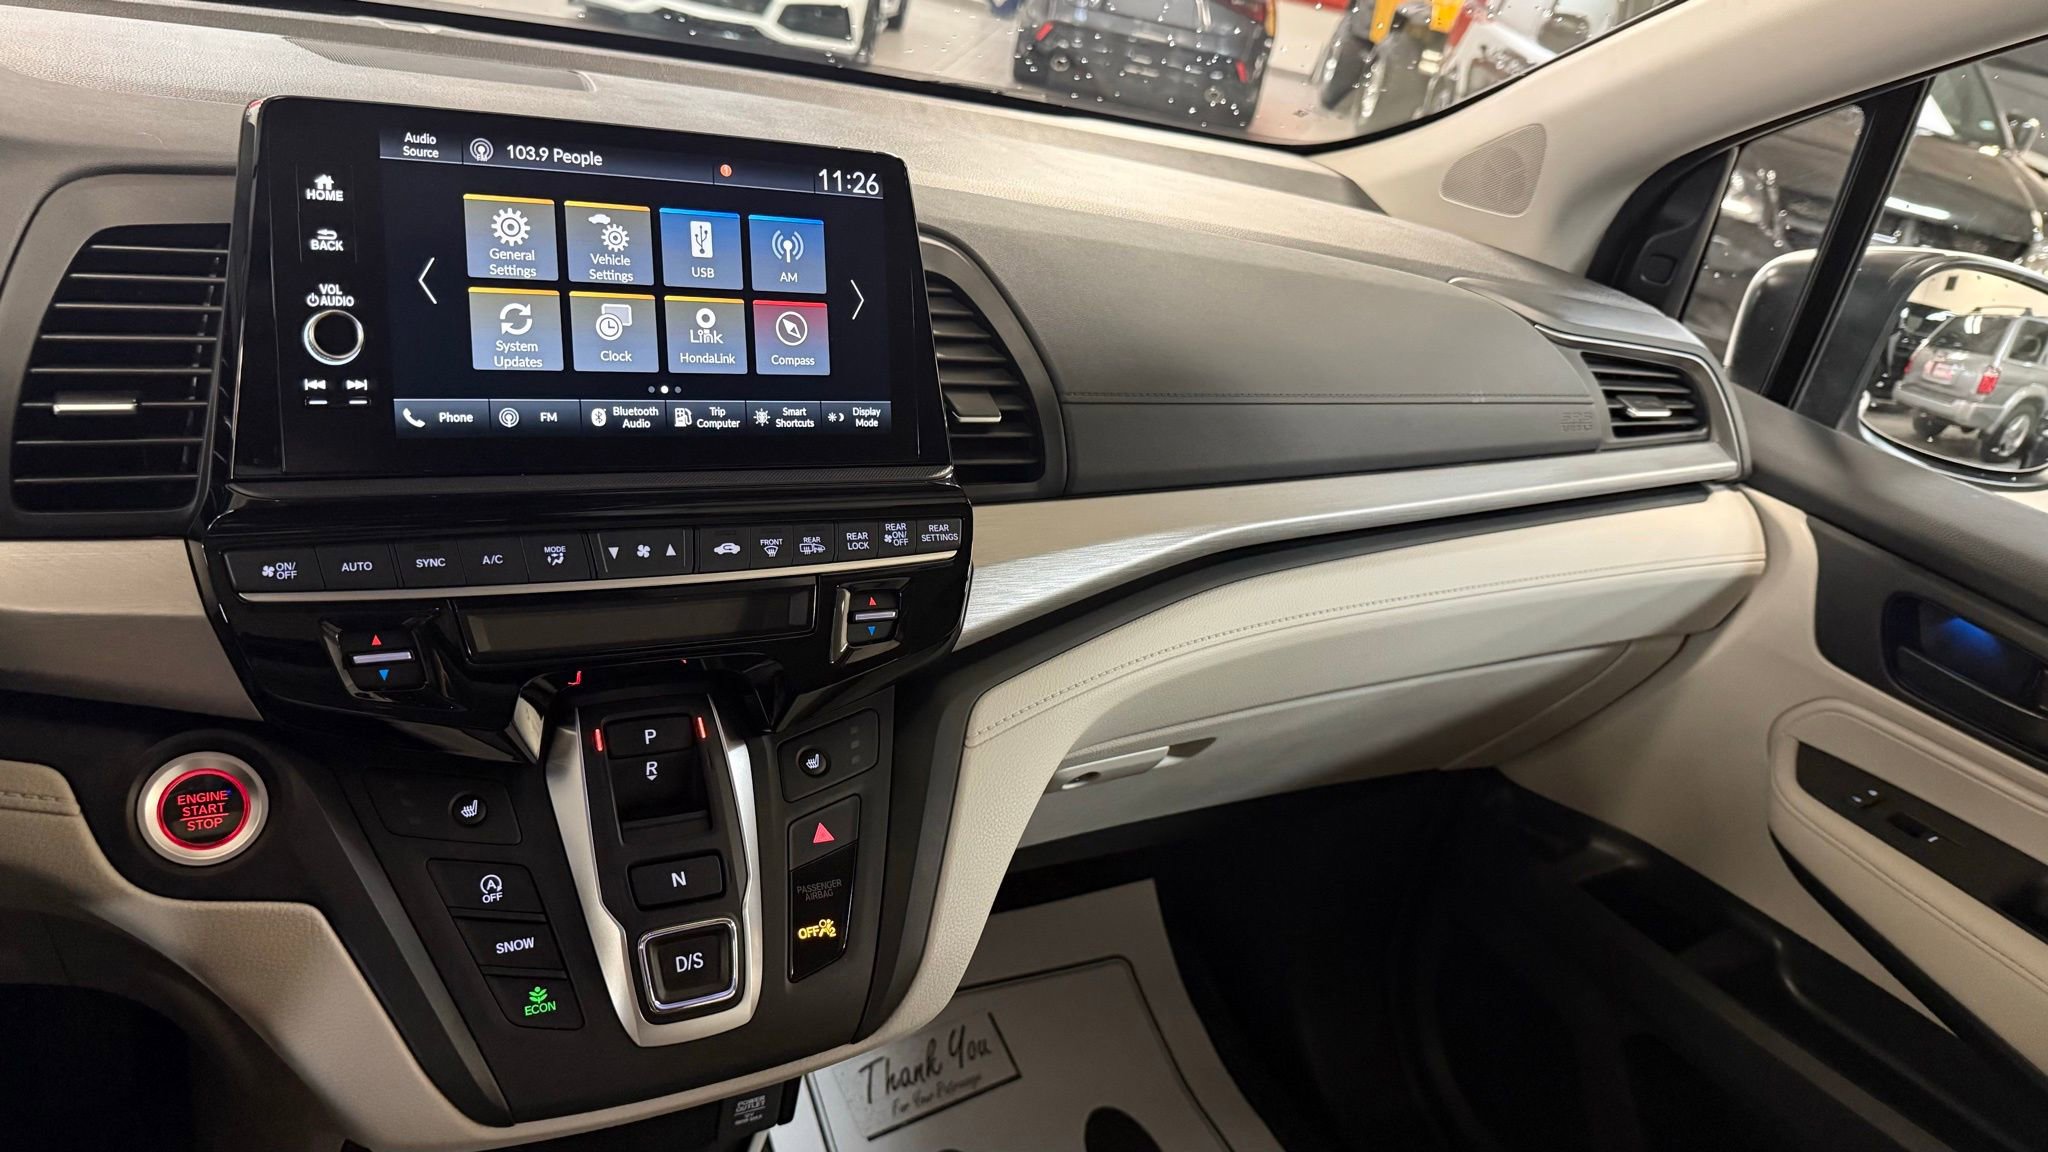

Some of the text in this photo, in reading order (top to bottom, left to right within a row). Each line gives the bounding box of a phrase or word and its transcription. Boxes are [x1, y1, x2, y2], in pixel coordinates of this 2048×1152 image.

[404, 132, 437, 145] Audio
[403, 146, 439, 158] Source
[506, 144, 603, 168] 103.9 People
[818, 168, 880, 195] 11:26
[305, 188, 344, 201] HOME
[310, 239, 344, 251] BACK
[489, 248, 536, 261] General
[590, 253, 631, 266] Vehicle
[489, 264, 537, 278] Settings
[589, 269, 634, 283] Settings
[691, 267, 715, 279] USB
[780, 272, 798, 283] AM
[319, 283, 343, 295] VOL
[320, 296, 355, 307] AUDIO
[496, 340, 538, 354] System
[600, 350, 632, 362] Clock
[680, 352, 736, 365] HondaLink
[771, 354, 815, 367] Compass
[494, 356, 543, 369] Updates
[439, 411, 473, 423] Phone
[540, 412, 558, 423] FM
[613, 406, 659, 417] Bluetooth
[709, 407, 726, 417] Trip
[782, 407, 806, 417] Smart
[852, 407, 881, 418] Display
[622, 418, 651, 429] Audio
[697, 419, 740, 430] Computer
[775, 418, 815, 428] Shortcuts
[855, 418, 878, 428] Mode
[885, 522, 907, 532] REAR
[928, 524, 950, 533] REAR
[803, 536, 821, 544] REAR
[846, 531, 869, 541] REAR
[892, 531, 907, 540] ON/
[921, 533, 959, 543] SETTINGS
[760, 538, 784, 547] FRONT
[847, 541, 870, 551] LOCK
[893, 537, 909, 547] OFF
[544, 545, 567, 554] MODE
[275, 561, 296, 572] ON/
[416, 557, 446, 569] SYNC
[482, 555, 504, 566] A/C
[341, 561, 373, 573] AUTO
[276, 569, 298, 580] OFF
[644, 728, 657, 745] P
[645, 761, 658, 776] R
[177, 790, 229, 806] ENGINE
[182, 802, 226, 817] START
[187, 817, 223, 831] STOP
[486, 879, 497, 891] A
[671, 871, 687, 887] N
[796, 878, 843, 895] PASSENGER
[482, 892, 503, 904] OFF
[805, 888, 834, 901] AIRBAG
[797, 925, 820, 940] OFF
[495, 936, 535, 954] SNOW
[675, 952, 704, 972] D/S
[524, 1001, 557, 1016] ECON
[858, 1038, 944, 1104] Thank
[948, 1024, 992, 1069] You
